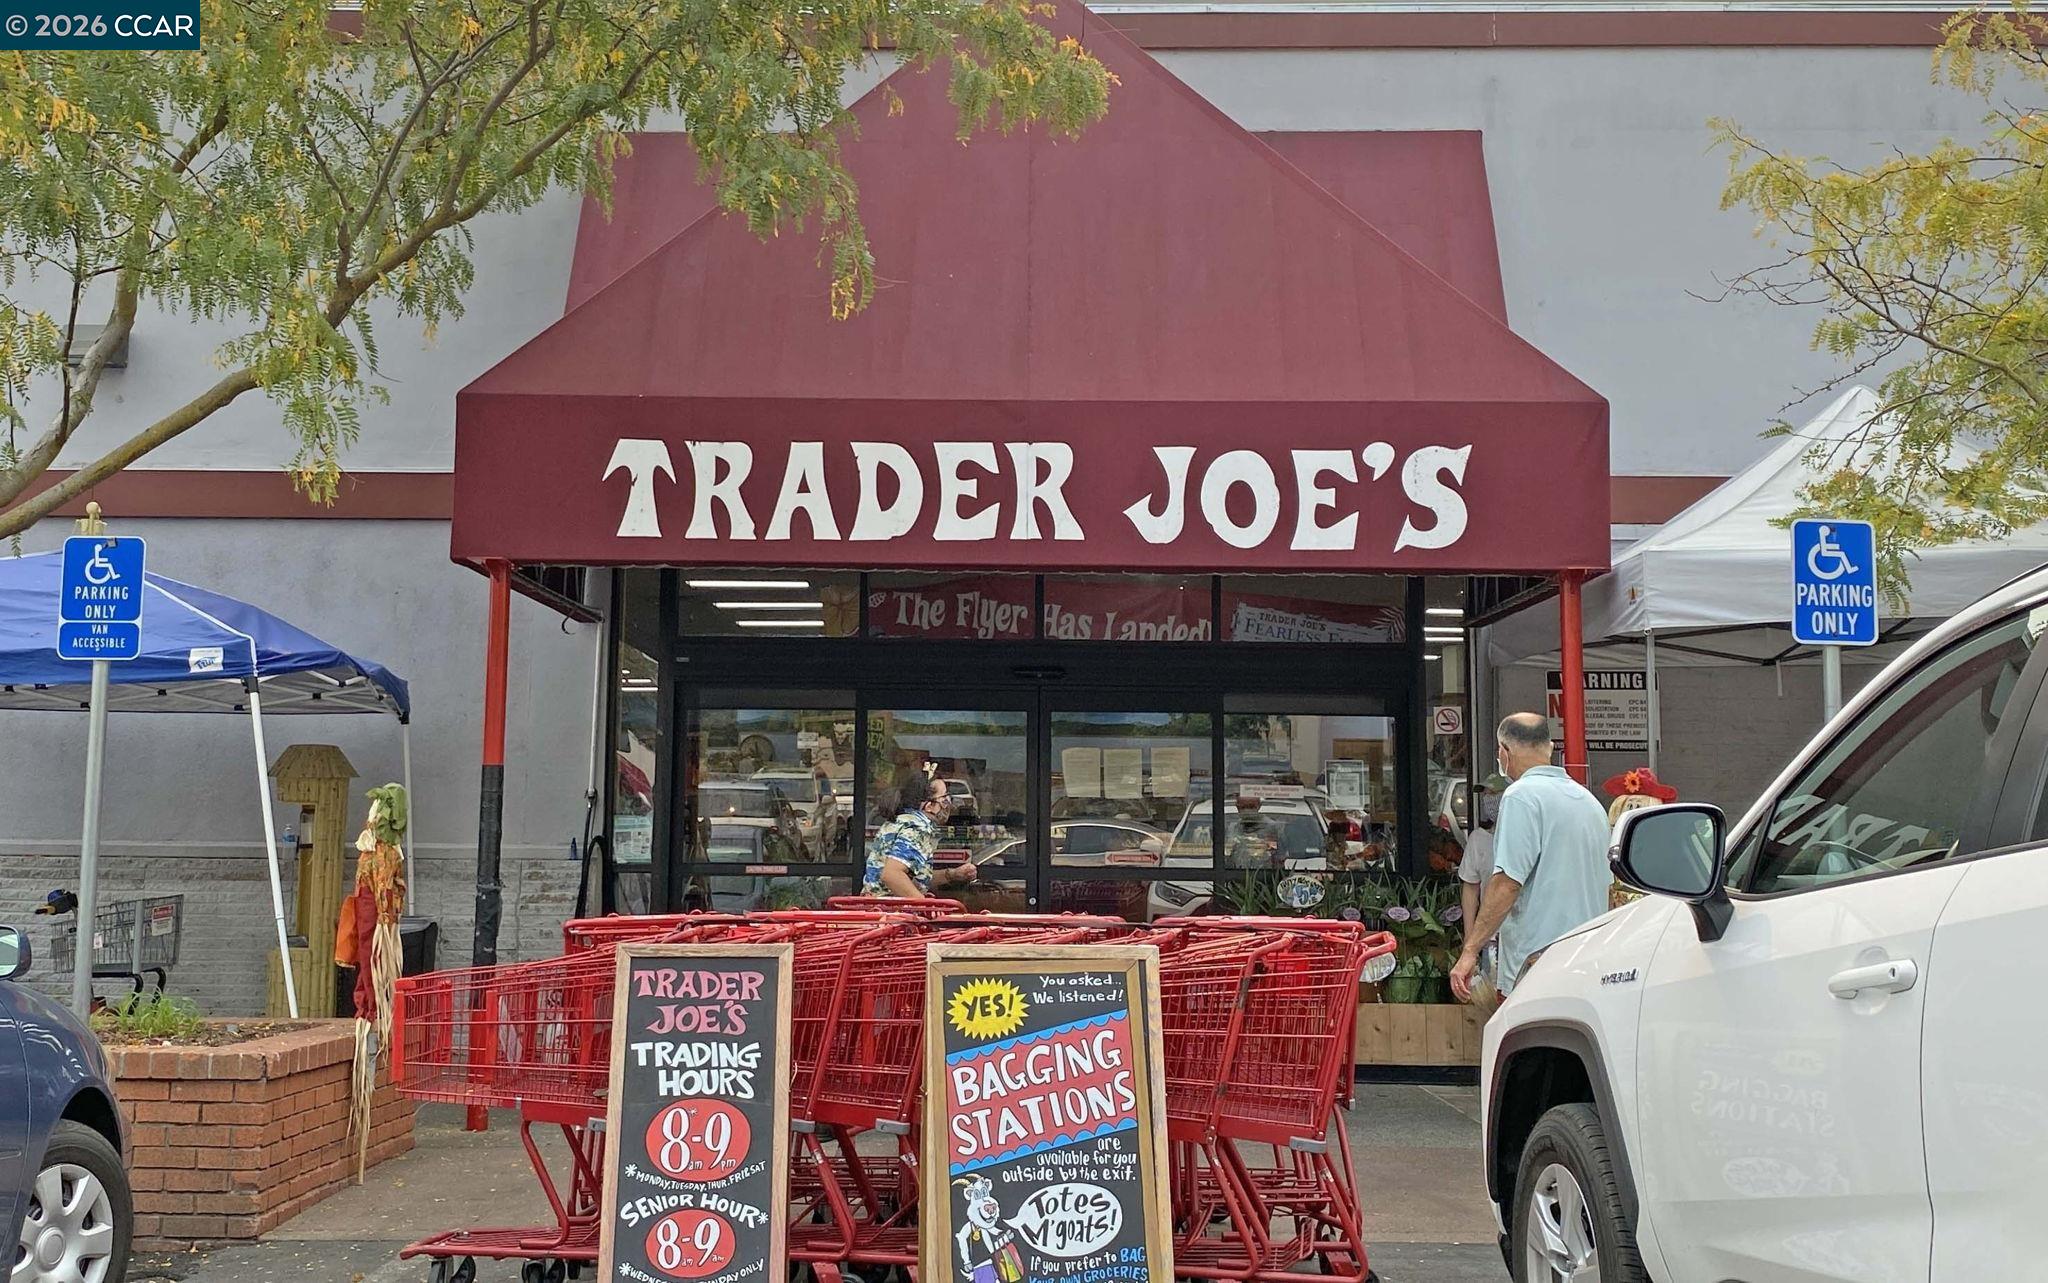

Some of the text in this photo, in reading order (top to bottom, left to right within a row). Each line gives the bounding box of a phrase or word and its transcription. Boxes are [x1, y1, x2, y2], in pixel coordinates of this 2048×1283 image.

[602, 438, 1473, 553] TRADER JOE'S
[74, 586, 129, 600] PARKING
[1796, 583, 1873, 608] PARKING
[84, 605, 117, 619] ONLY
[893, 591, 946, 630] The
[956, 591, 1029, 639] Flyer
[1044, 604, 1094, 640] Has
[1259, 613, 1327, 631] TRADER JOE'S
[1811, 611, 1859, 635] ONLY
[91, 624, 109, 634] VAN
[72, 638, 126, 649] ACCESSIBLE
[1560, 672, 1643, 689] RNING
[633, 968, 765, 1001] TRADER
[1039, 973, 1122, 988] You asked...
[961, 993, 1014, 1022] YES!
[1033, 989, 1124, 1004] We listened!
[646, 1000, 749, 1036] JOE'S
[631, 1041, 762, 1070] TRADING
[951, 1029, 1123, 1107] BAGGING
[658, 1068, 756, 1099] HOURS
[951, 1070, 1138, 1156] STATIONS
[1097, 1137, 1122, 1151] are
[689, 1159, 736, 1171] am pm
[1036, 1150, 1137, 1168] available for you
[1059, 1167, 1077, 1182] by
[1080, 1167, 1098, 1181] the
[1102, 1165, 1136, 1181] exit.
[620, 1193, 694, 1228] SENIOR
[1028, 1187, 1111, 1218] Totes
[1021, 1208, 1117, 1250] M'goats!
[740, 1258, 765, 1277] ONLY
[1030, 1246, 1147, 1276] If you prefer to BAG
[1083, 1265, 1148, 1282] GROCERIES
